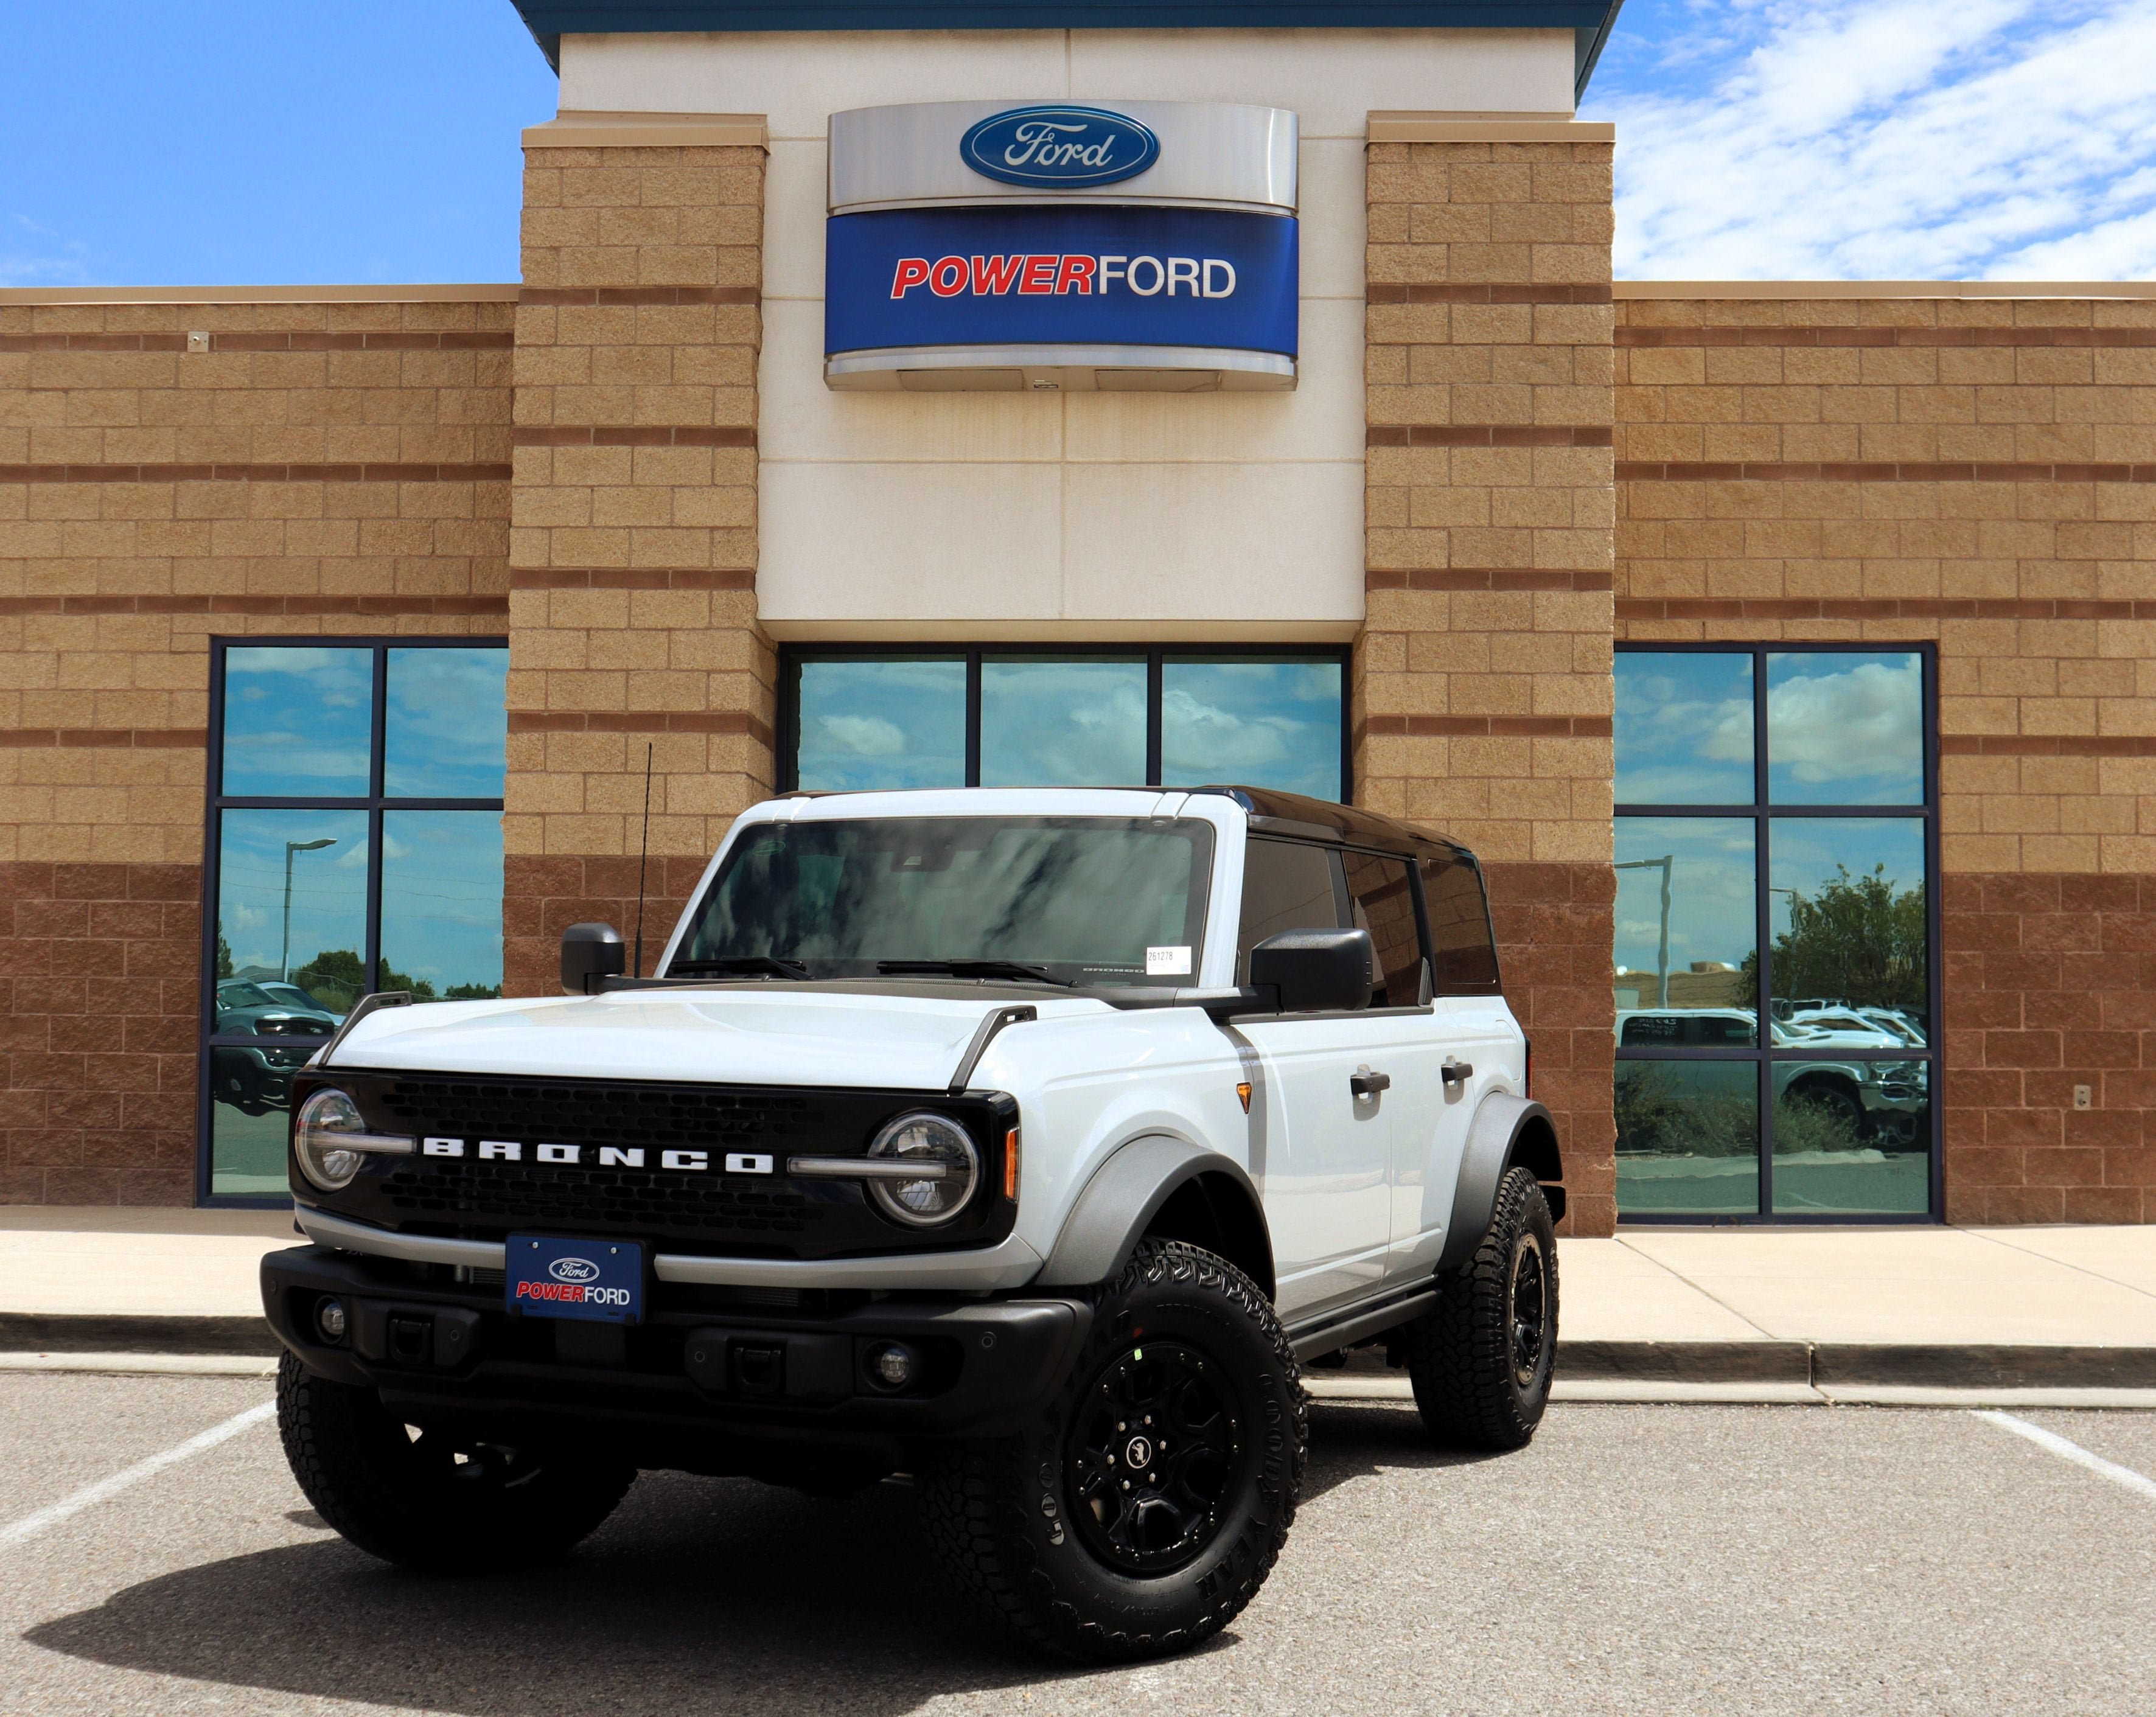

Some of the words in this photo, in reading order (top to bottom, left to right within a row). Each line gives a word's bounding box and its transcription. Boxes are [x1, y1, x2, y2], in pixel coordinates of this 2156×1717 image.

[1004, 121, 1116, 167] Ford
[1148, 952, 1173, 961] 261278
[423, 1137, 774, 1174] BRONCO
[559, 1261, 589, 1278] Ford
